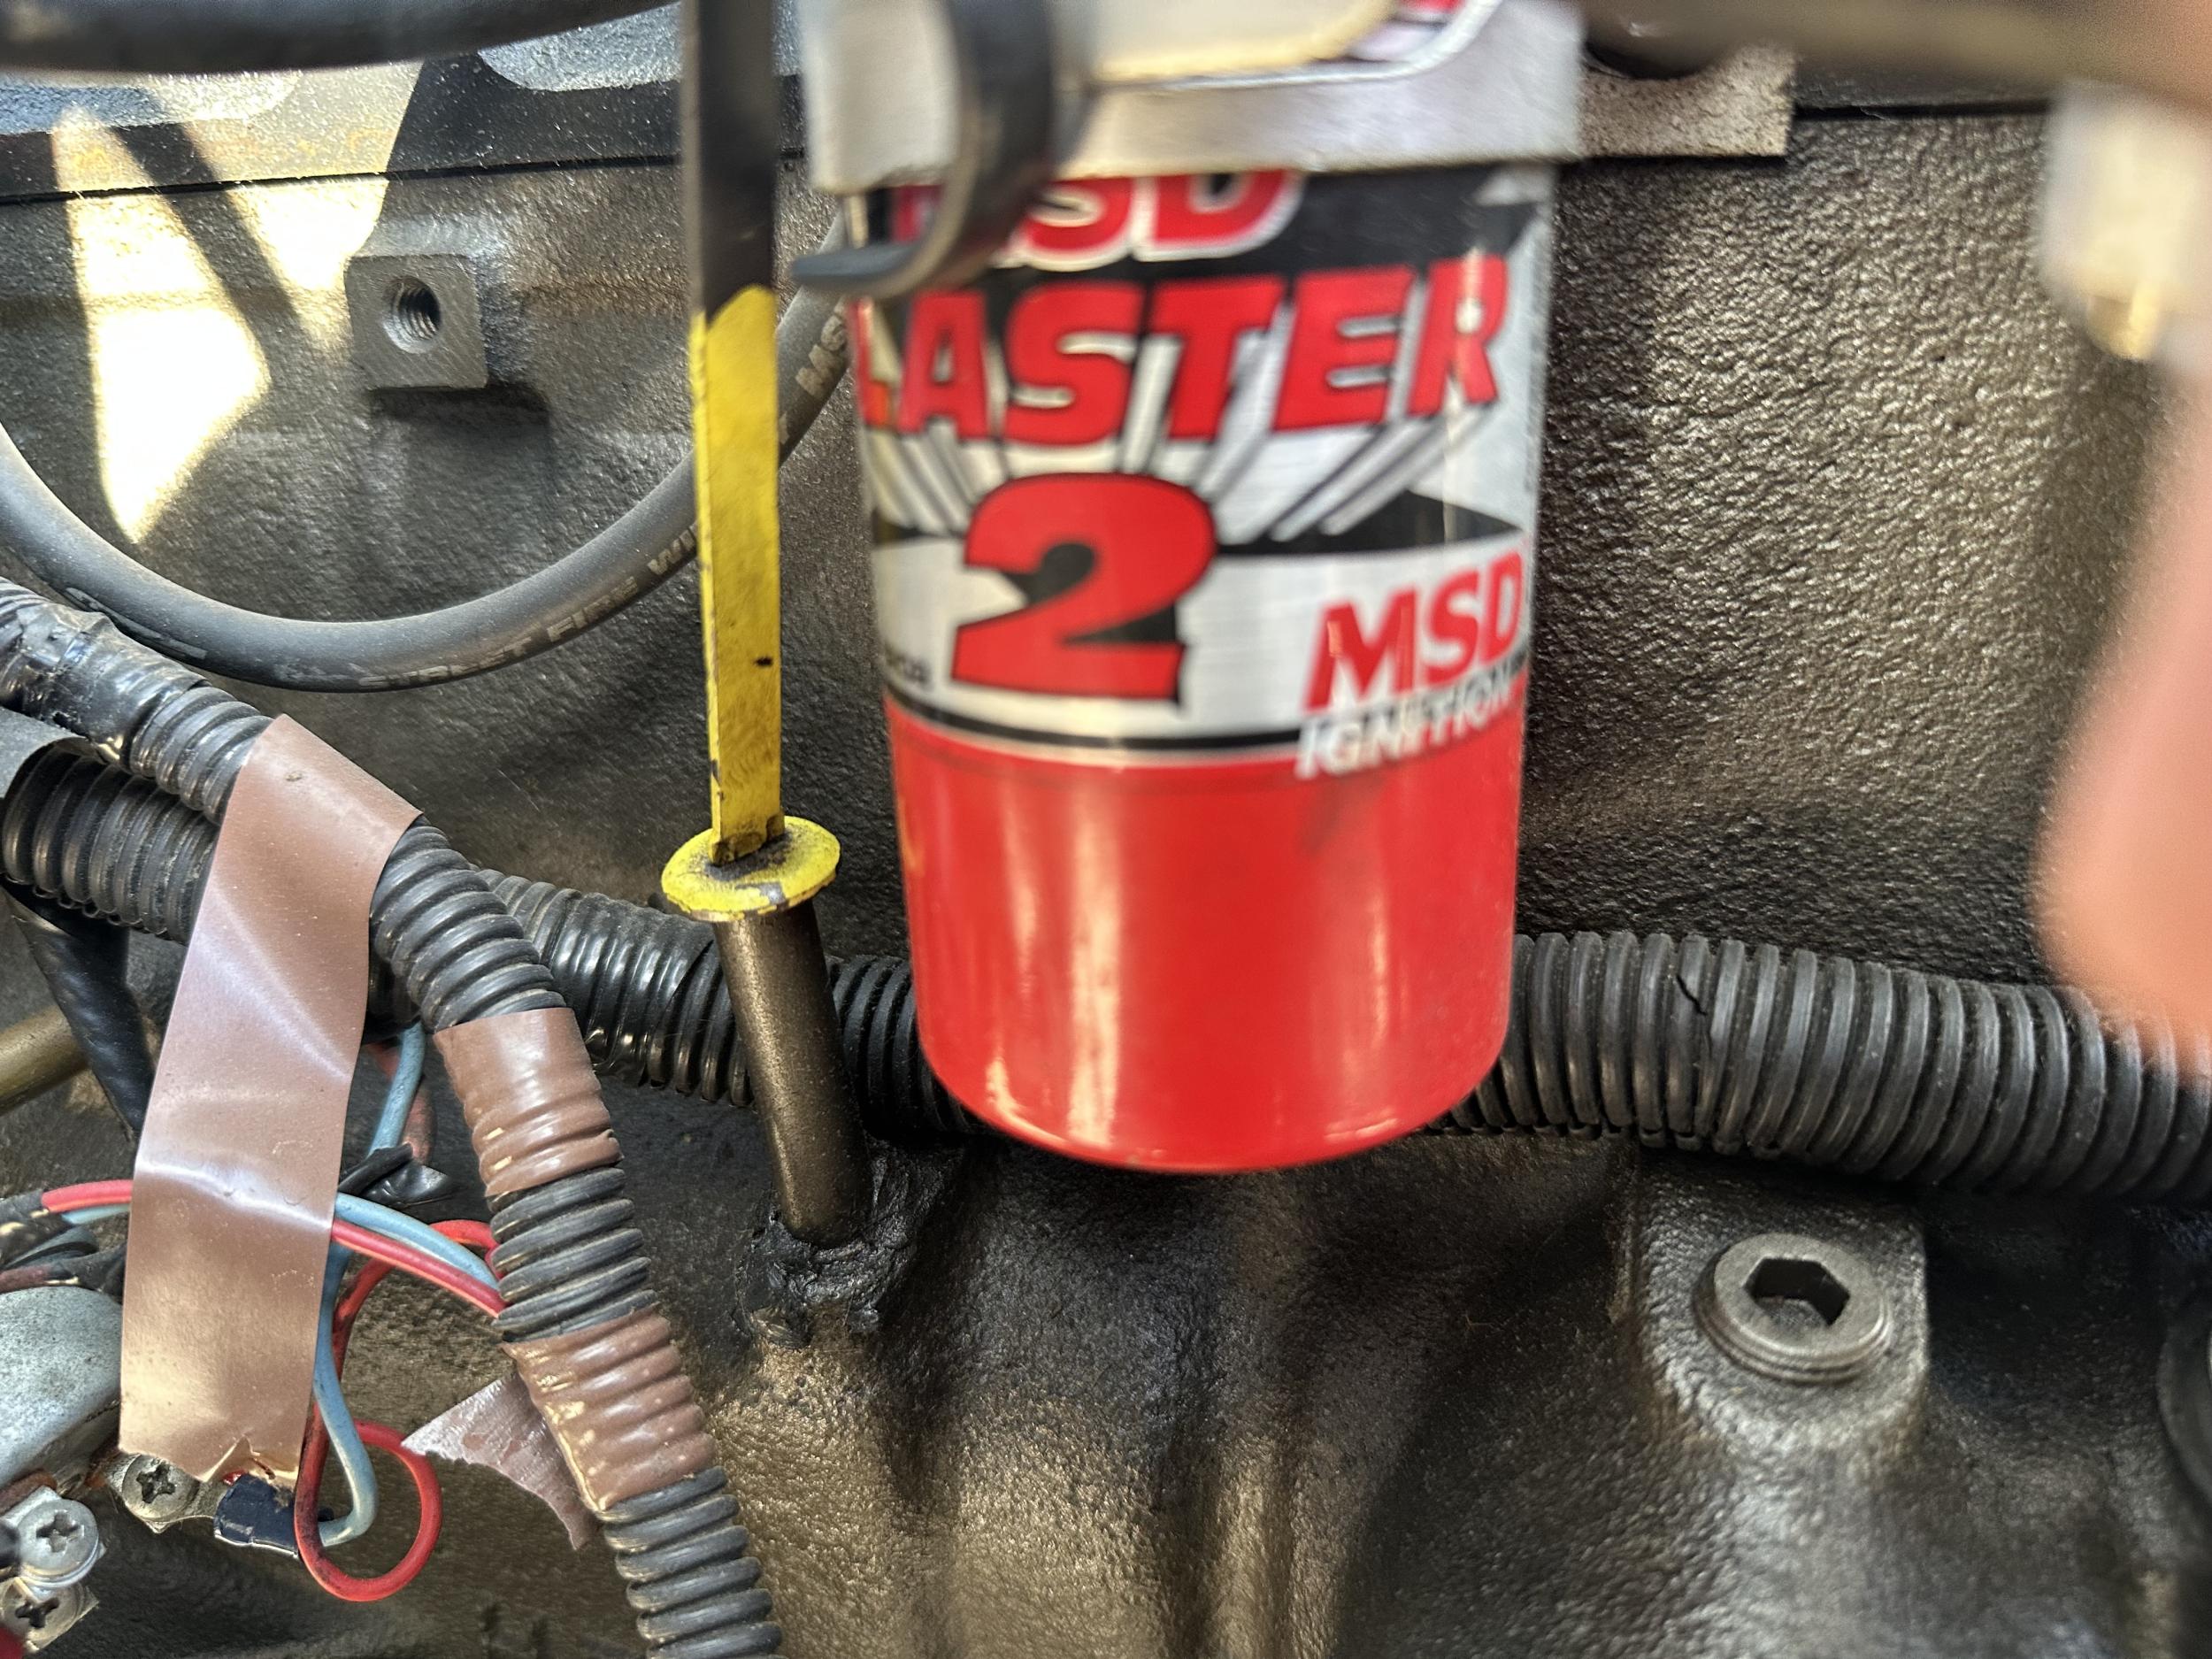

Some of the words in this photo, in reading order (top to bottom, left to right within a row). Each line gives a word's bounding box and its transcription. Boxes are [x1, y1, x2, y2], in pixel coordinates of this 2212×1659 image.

[892, 170, 1308, 272] SD
[950, 472, 1217, 704] 2
[1302, 550, 1522, 713] MSD
